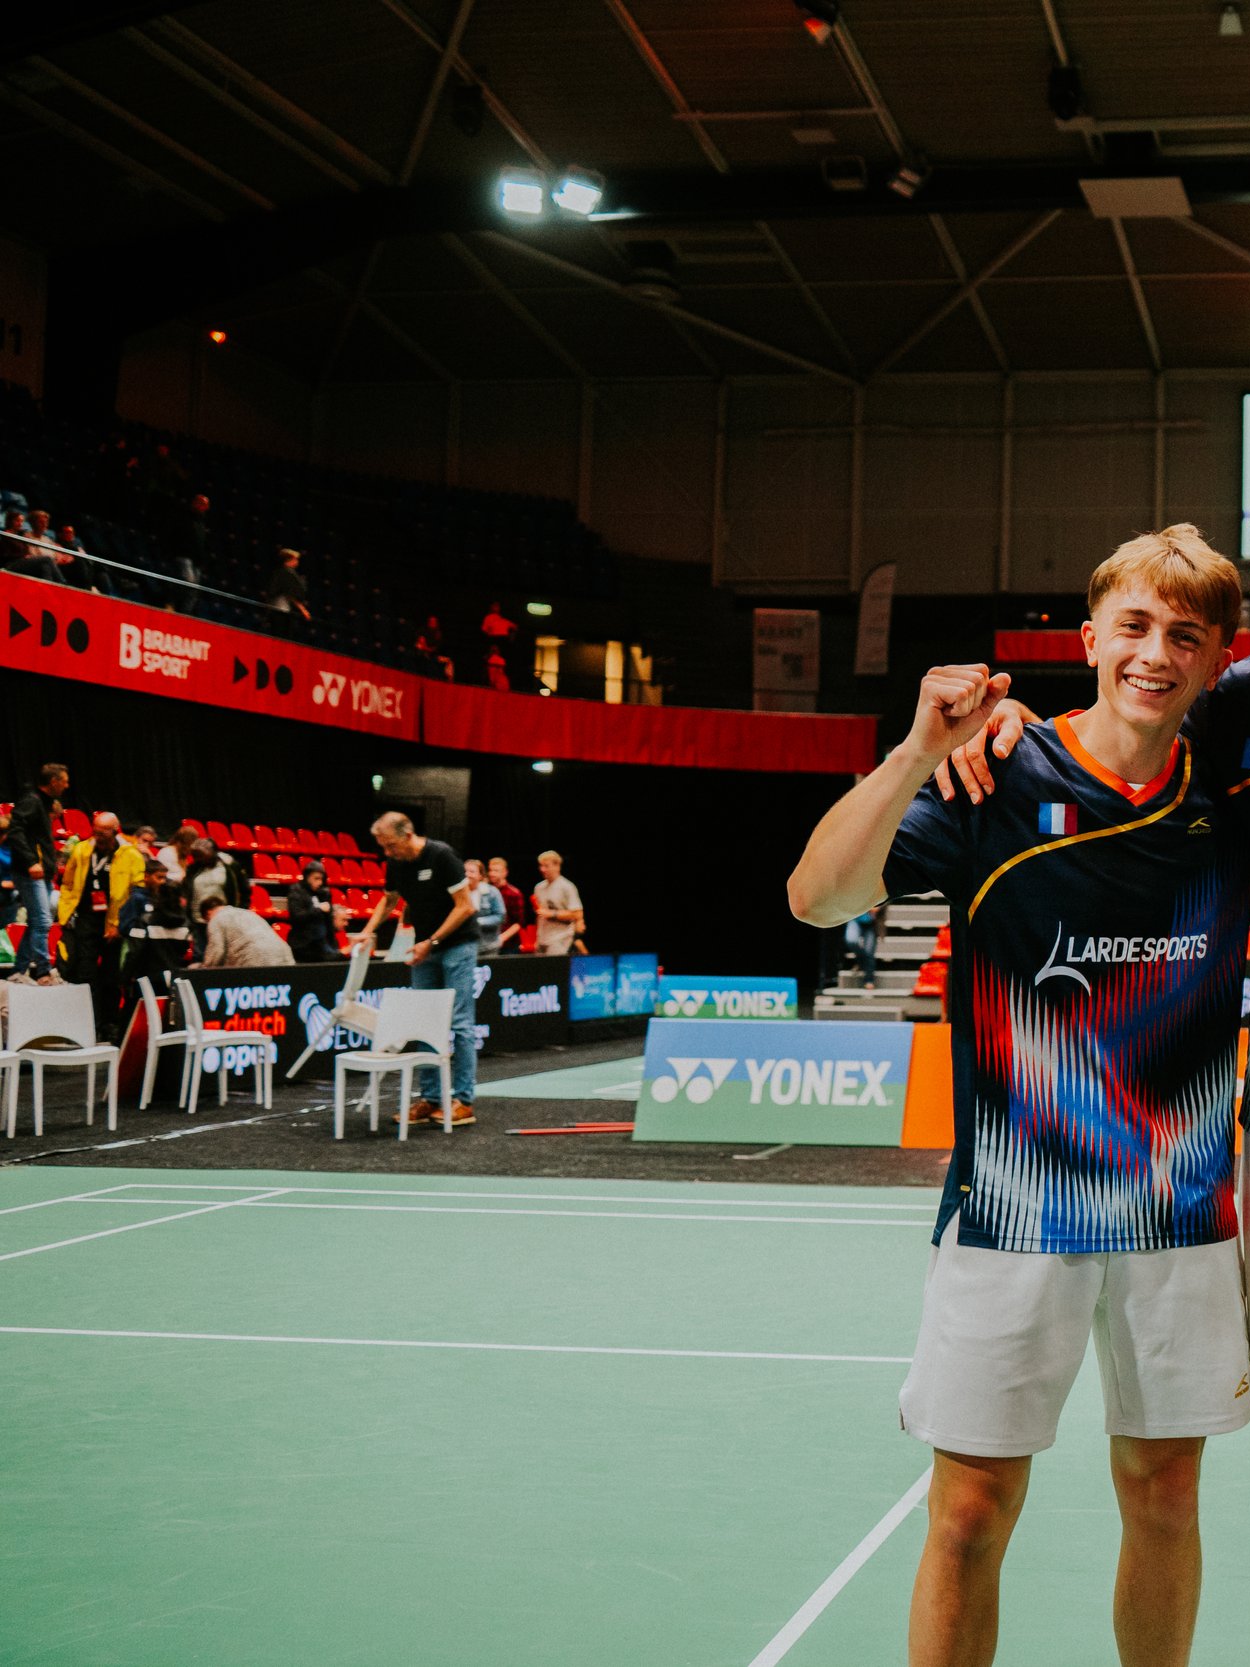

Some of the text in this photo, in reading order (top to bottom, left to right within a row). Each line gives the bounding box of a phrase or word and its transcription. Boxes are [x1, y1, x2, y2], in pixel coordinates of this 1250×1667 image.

[143, 628, 211, 661] BRABANT
[143, 651, 191, 680] SPORT
[350, 679, 403, 719] YONEX
[1066, 933, 1208, 963] LARDESPORTS
[225, 985, 291, 1015] yonex
[499, 985, 561, 1017] TeamNL
[711, 990, 790, 1017] YONEX
[224, 1010, 286, 1035] dutch
[745, 1058, 892, 1106] YONEX
